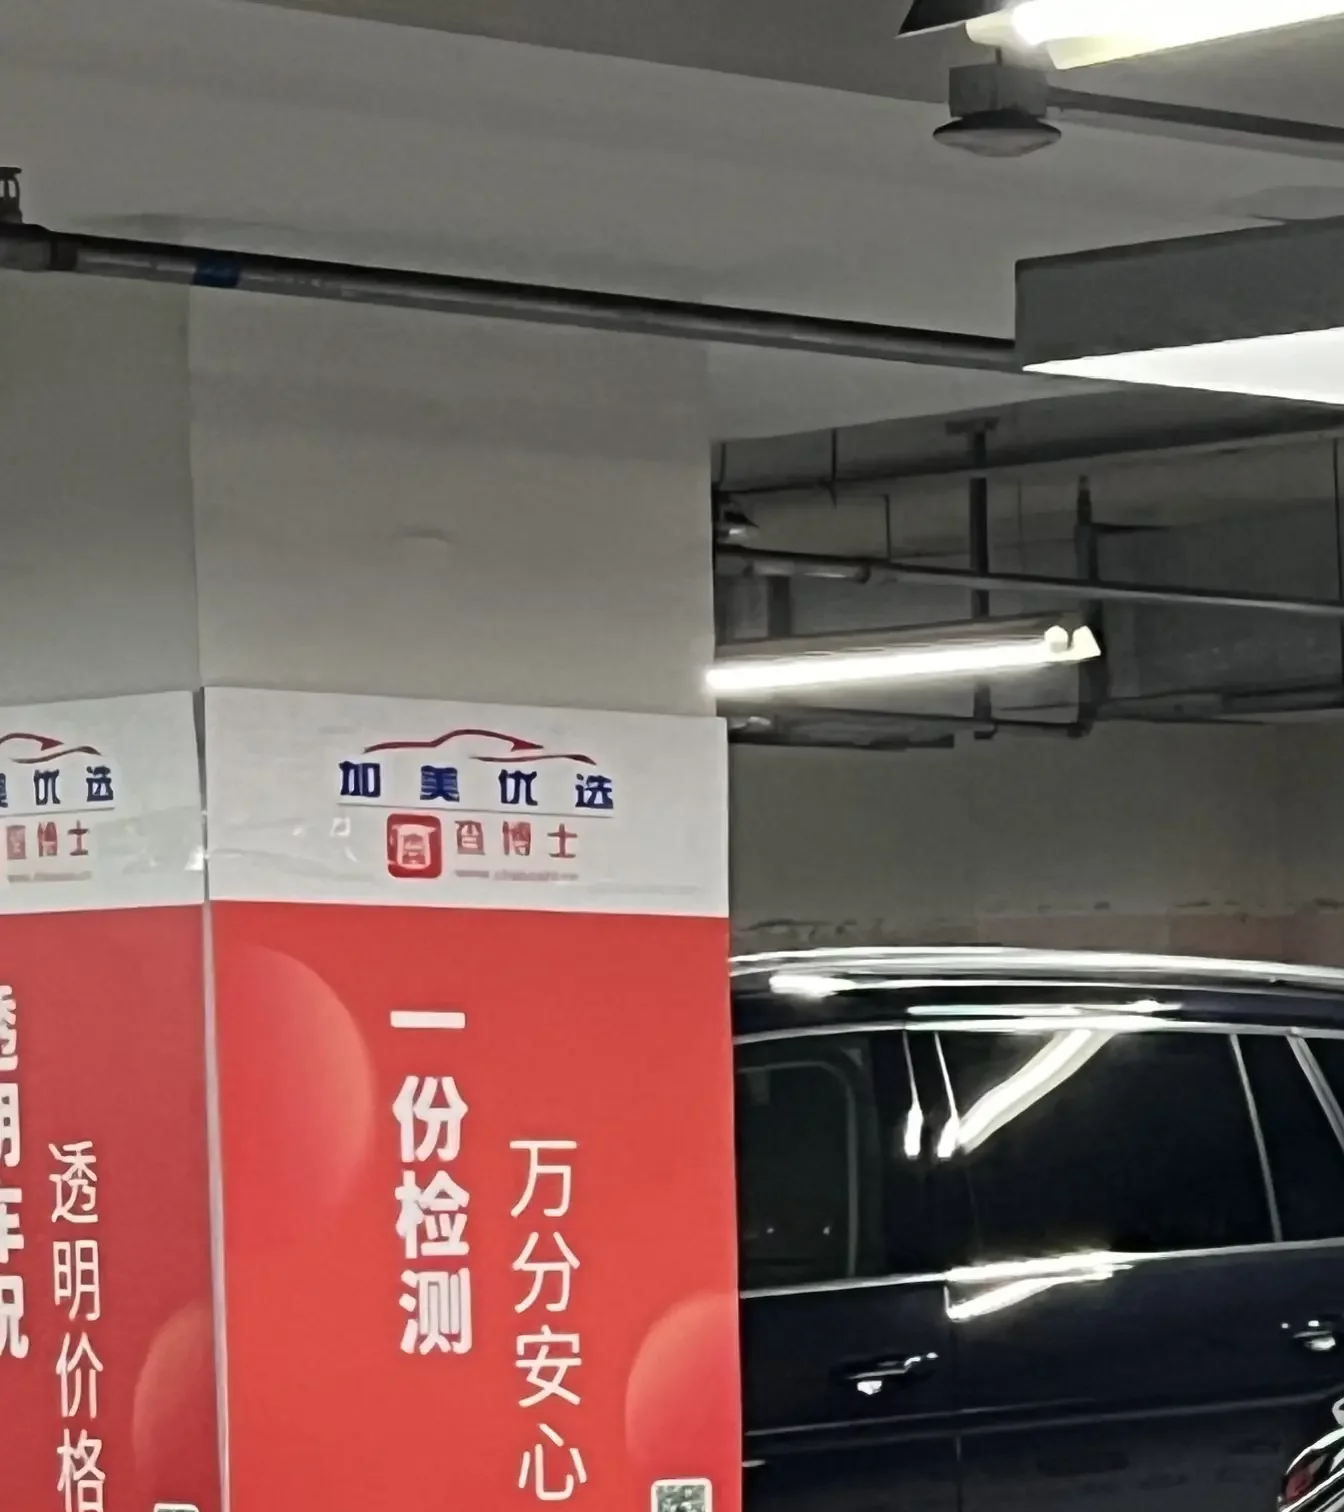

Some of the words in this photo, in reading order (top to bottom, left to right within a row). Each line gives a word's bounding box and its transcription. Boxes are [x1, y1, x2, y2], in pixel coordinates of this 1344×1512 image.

[0, 766, 114, 808] 优选
[339, 760, 614, 809] 加美优选
[454, 820, 578, 859] 查博士
[390, 1010, 473, 1356] 一份检测
[509, 1140, 588, 1501] 万分安心
